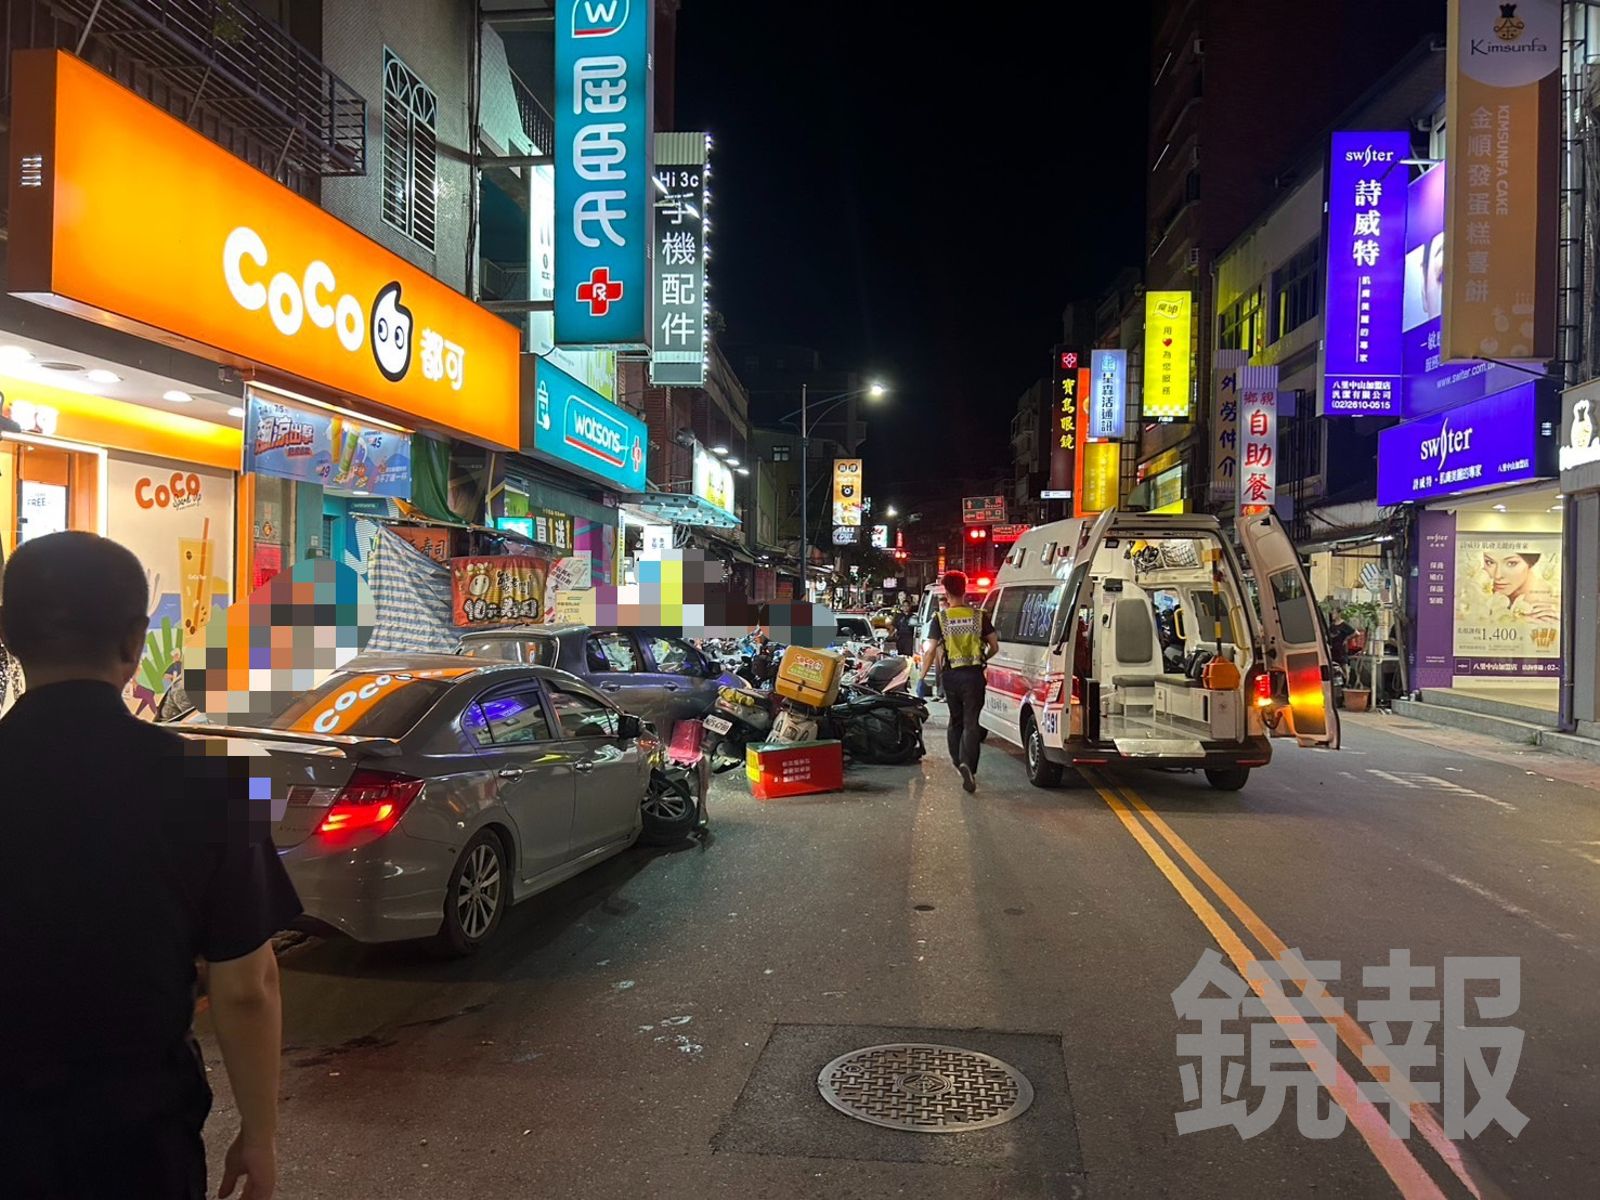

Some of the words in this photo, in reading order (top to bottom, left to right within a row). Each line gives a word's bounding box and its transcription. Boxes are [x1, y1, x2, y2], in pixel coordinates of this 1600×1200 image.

[1471, 38, 1548, 55] Kimsunfa
[573, 55, 627, 248] 屈臣氏
[659, 172, 676, 188] Hi
[1496, 105, 1510, 177] KIMSUNFA
[1352, 179, 1383, 267] 詩威特
[1465, 105, 1493, 304] 金順發蛋糕喜餅
[1496, 180, 1508, 216] CAKE
[222, 226, 366, 352] CoCo
[661, 192, 696, 346] 手機配件
[420, 327, 465, 391] 都可
[573, 409, 621, 452] watsons
[1060, 378, 1076, 449] 寶島眼鏡
[1217, 372, 1237, 478] 外勞仲介
[1243, 409, 1273, 502] 自助餐
